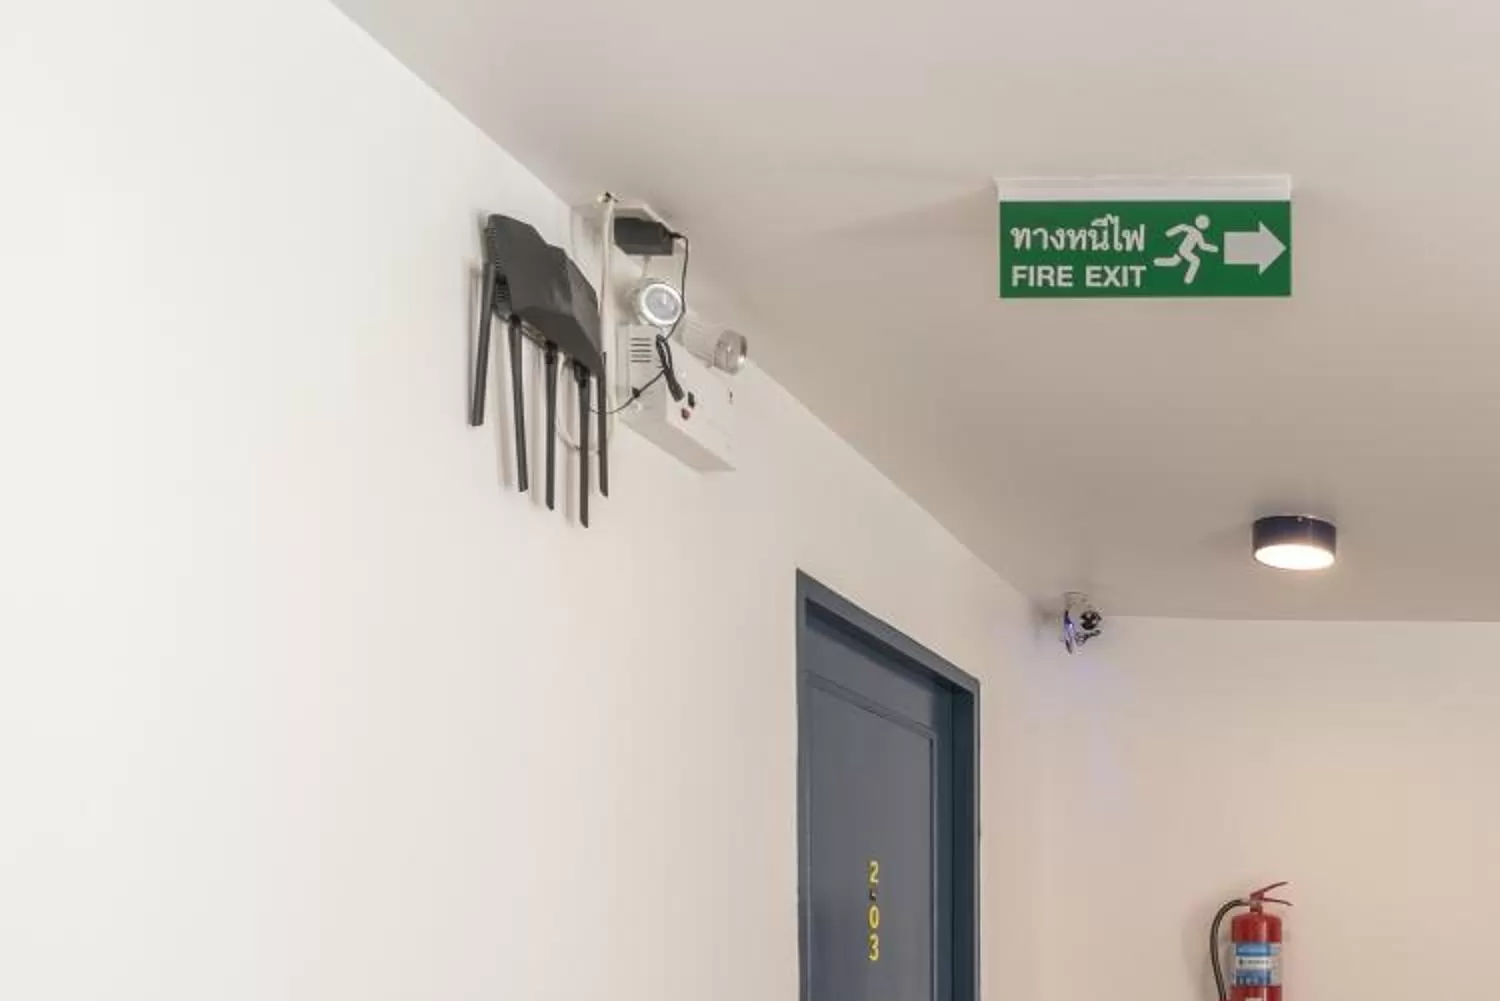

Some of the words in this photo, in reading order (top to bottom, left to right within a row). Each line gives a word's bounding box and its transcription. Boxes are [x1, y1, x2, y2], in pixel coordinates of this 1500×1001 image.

[1010, 213, 1146, 252] ทางหนีไฟ
[1011, 265, 1073, 287] FIRE
[1085, 265, 1147, 287] EXIT
